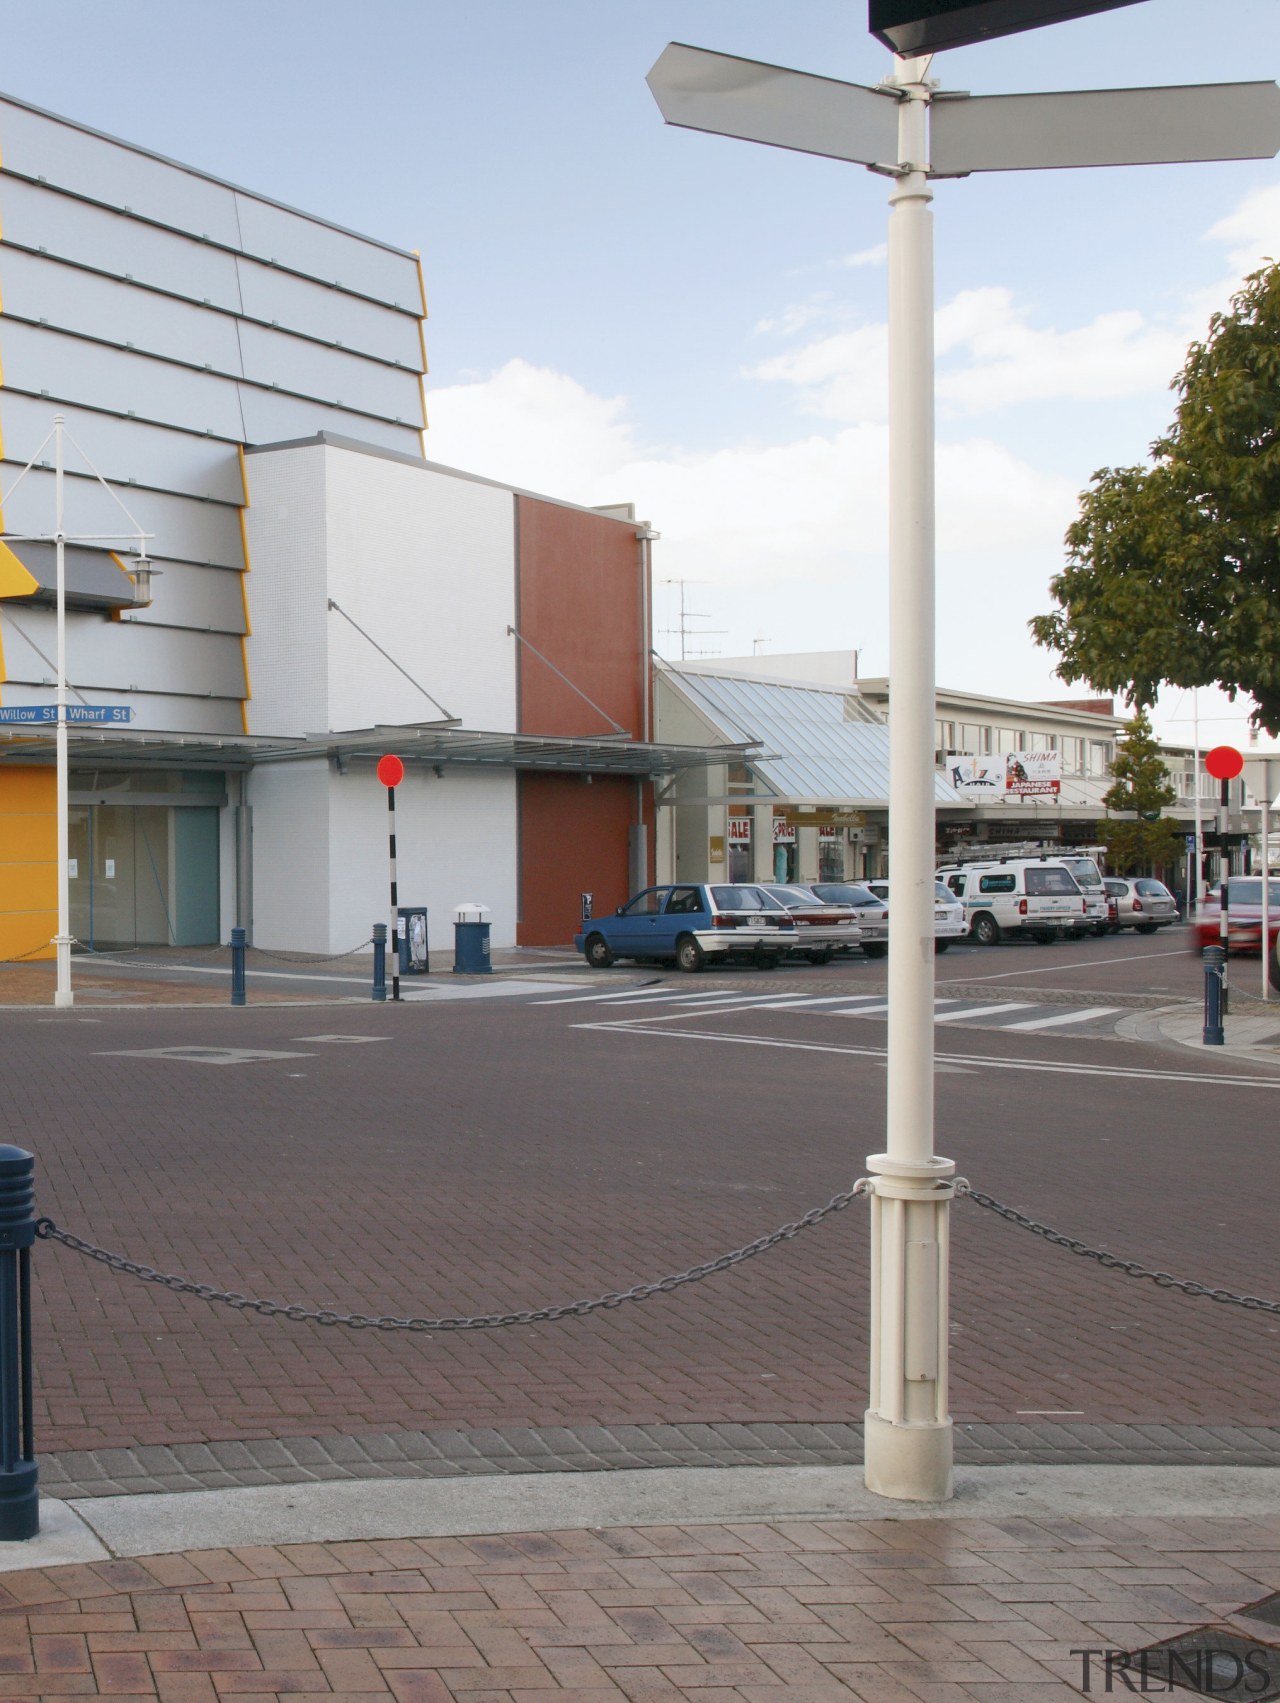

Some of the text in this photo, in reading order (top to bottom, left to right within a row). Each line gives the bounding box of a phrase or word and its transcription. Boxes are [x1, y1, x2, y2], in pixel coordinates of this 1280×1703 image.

[0, 708, 55, 720] Willow St
[69, 708, 127, 720] Wharf St
[1024, 752, 1057, 762] SHIMA
